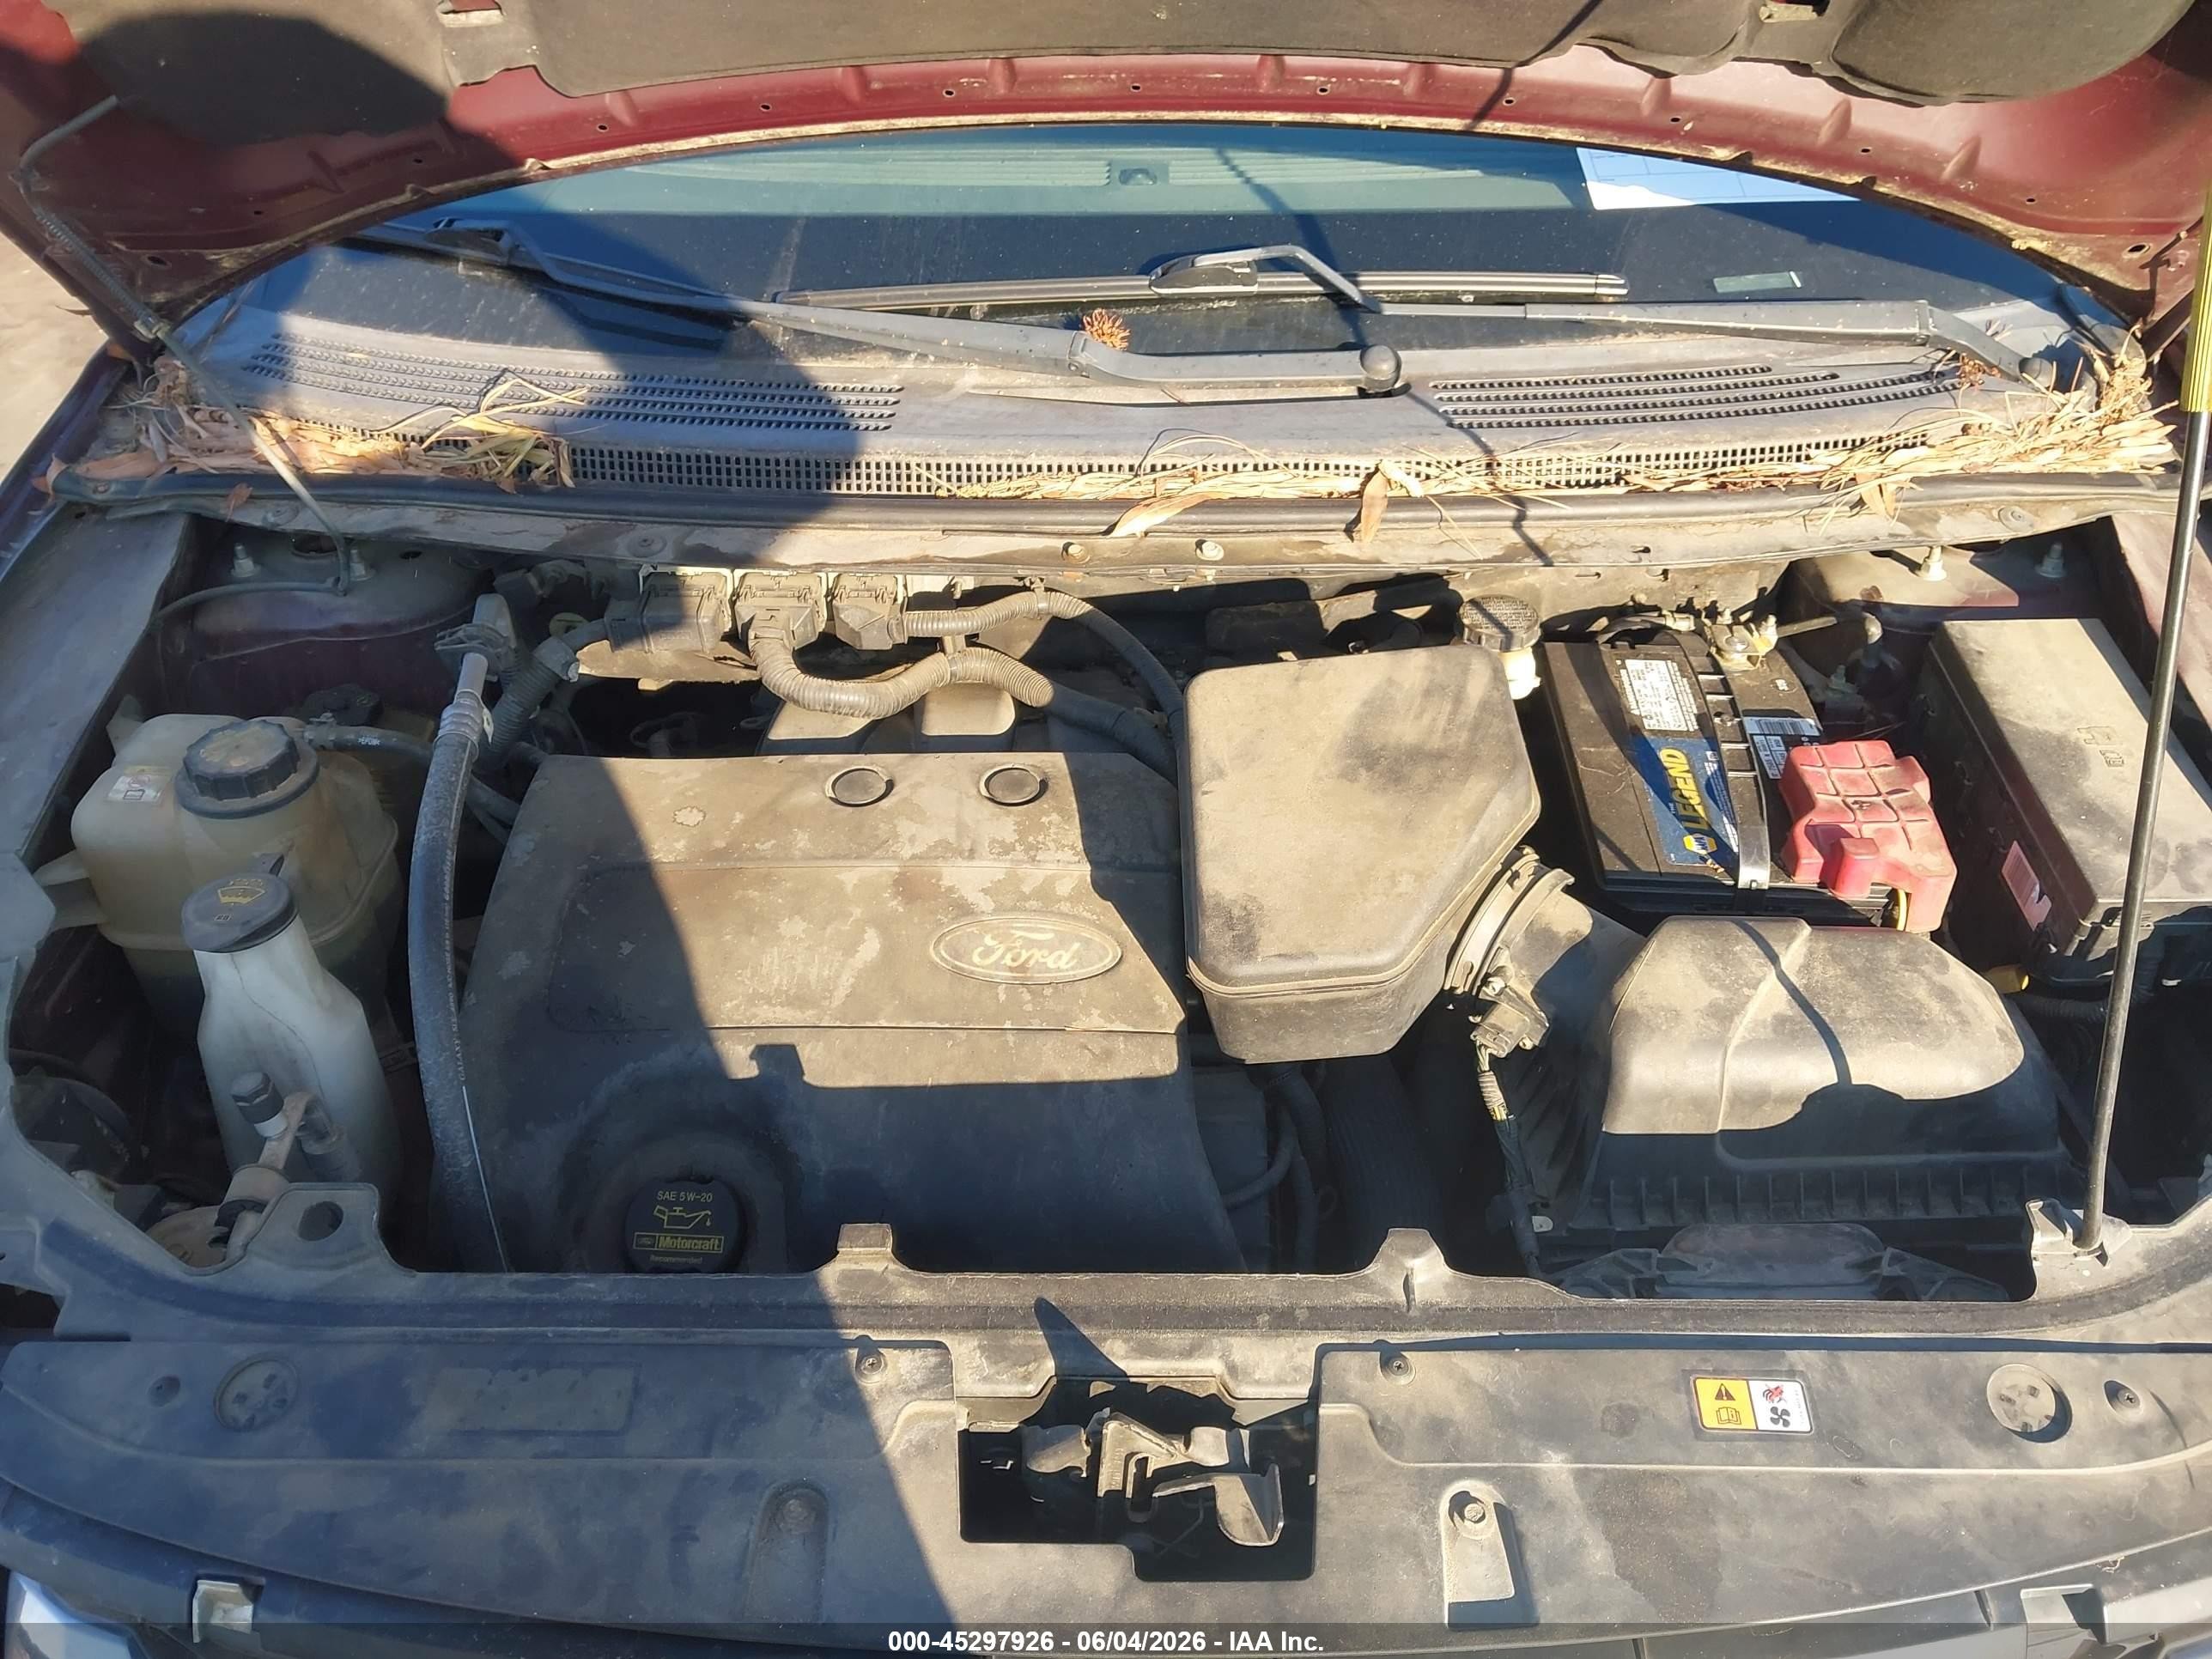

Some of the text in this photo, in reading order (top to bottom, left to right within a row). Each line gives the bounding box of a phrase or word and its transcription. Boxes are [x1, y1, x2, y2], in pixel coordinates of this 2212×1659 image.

[1659, 748, 1709, 830] LEGEND
[1692, 836, 1707, 851] NAPA
[972, 930, 1080, 969] Ford
[657, 1190, 713, 1203] SAE 5W-20
[658, 1236, 721, 1251] Motorcraft
[650, 1255, 702, 1265] Recommended
